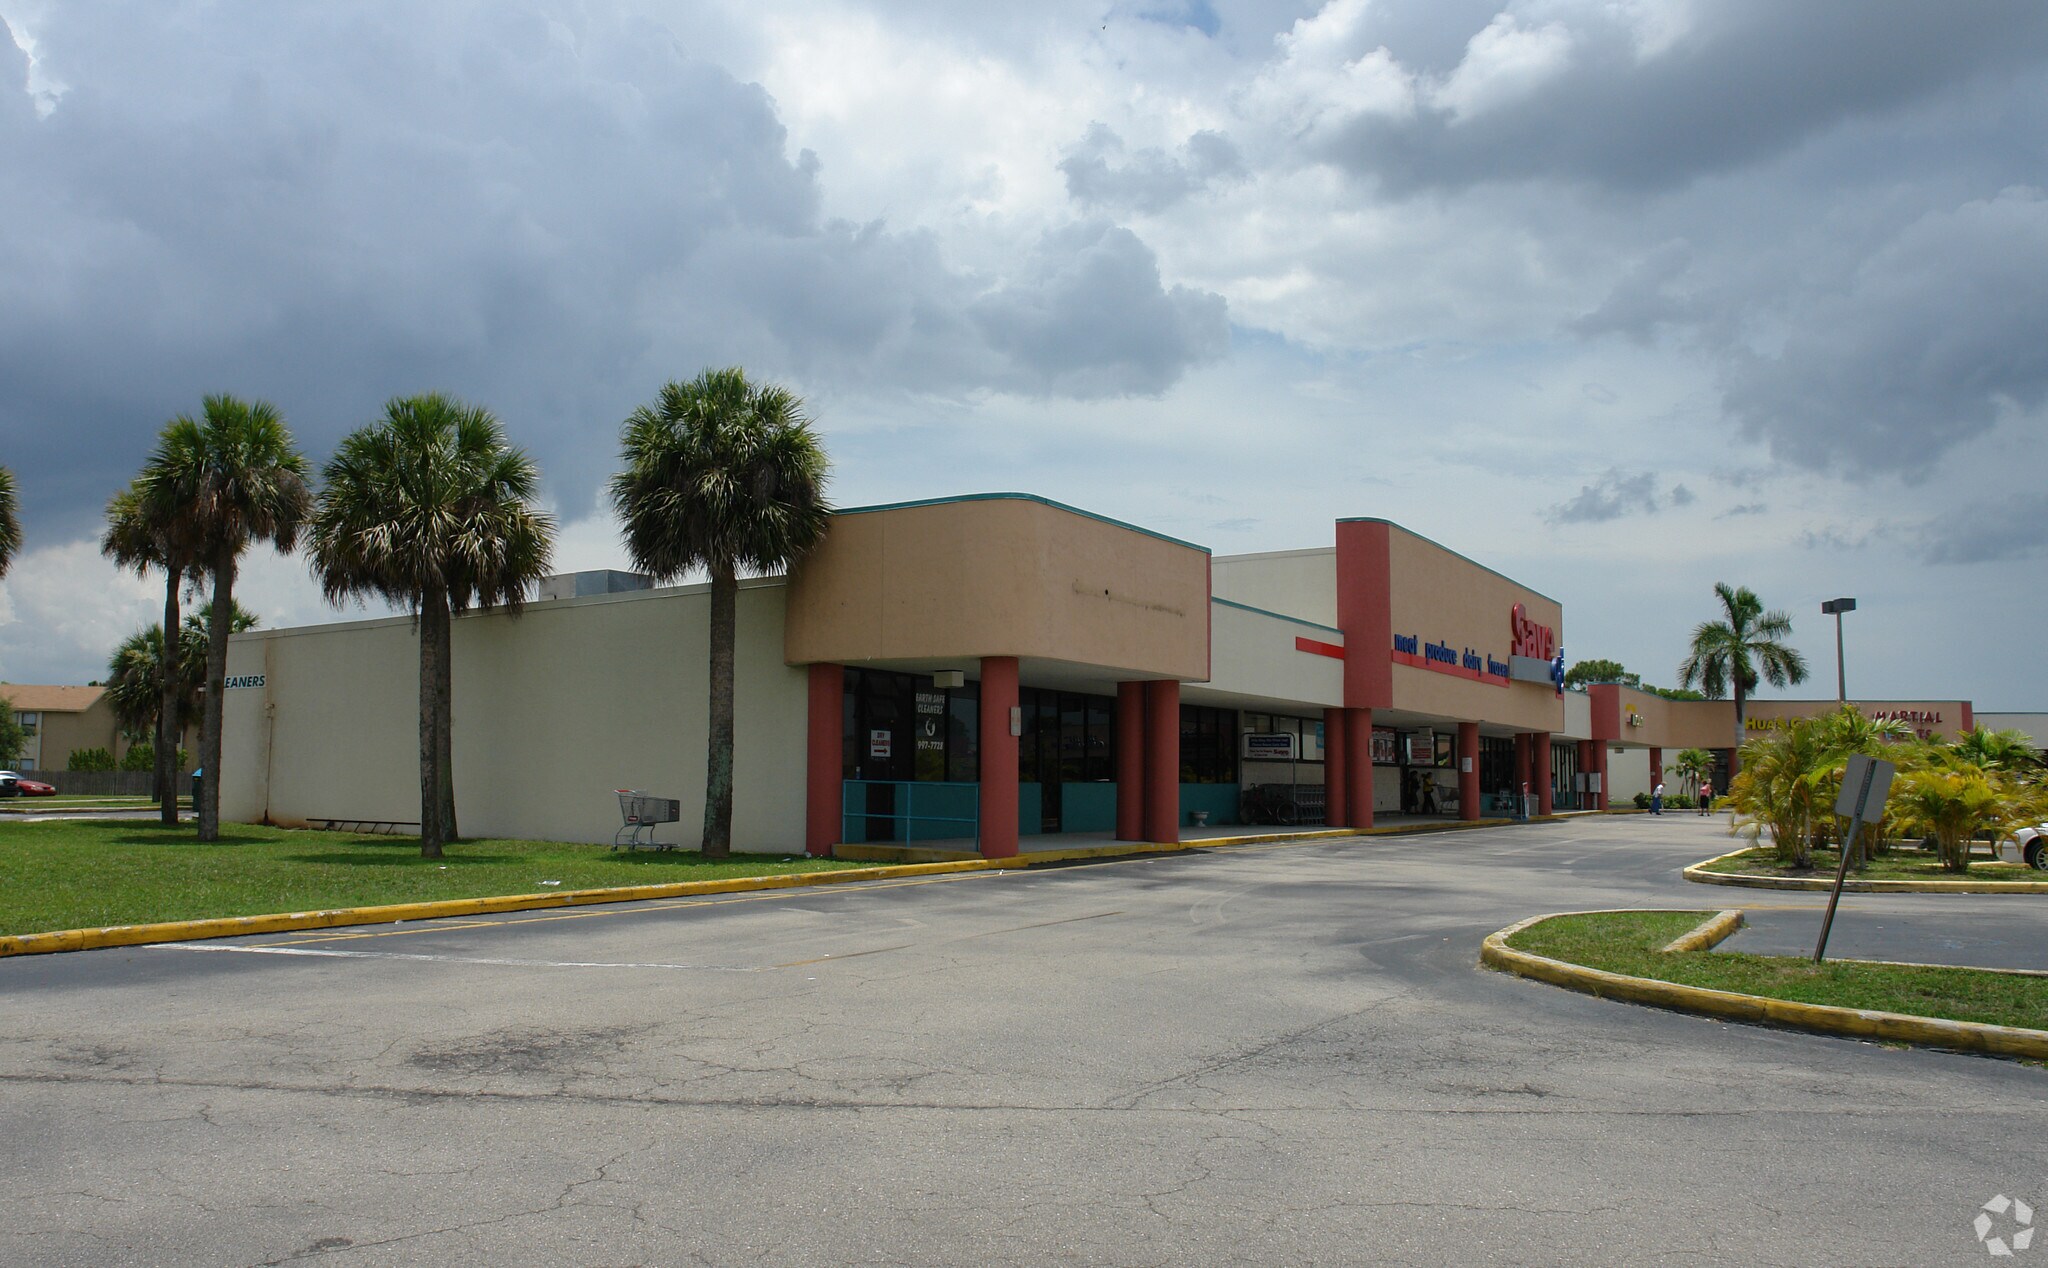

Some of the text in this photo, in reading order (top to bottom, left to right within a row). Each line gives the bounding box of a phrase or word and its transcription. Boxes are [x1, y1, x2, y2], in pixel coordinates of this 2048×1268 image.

[1511, 603, 1555, 661] Save
[1394, 633, 1509, 677] meat produce dairy frozen
[225, 675, 265, 689] EANERS
[915, 693, 945, 704] EARTH SAFE
[917, 704, 943, 714] CLEANERS
[1874, 711, 1942, 724] MARTIAL
